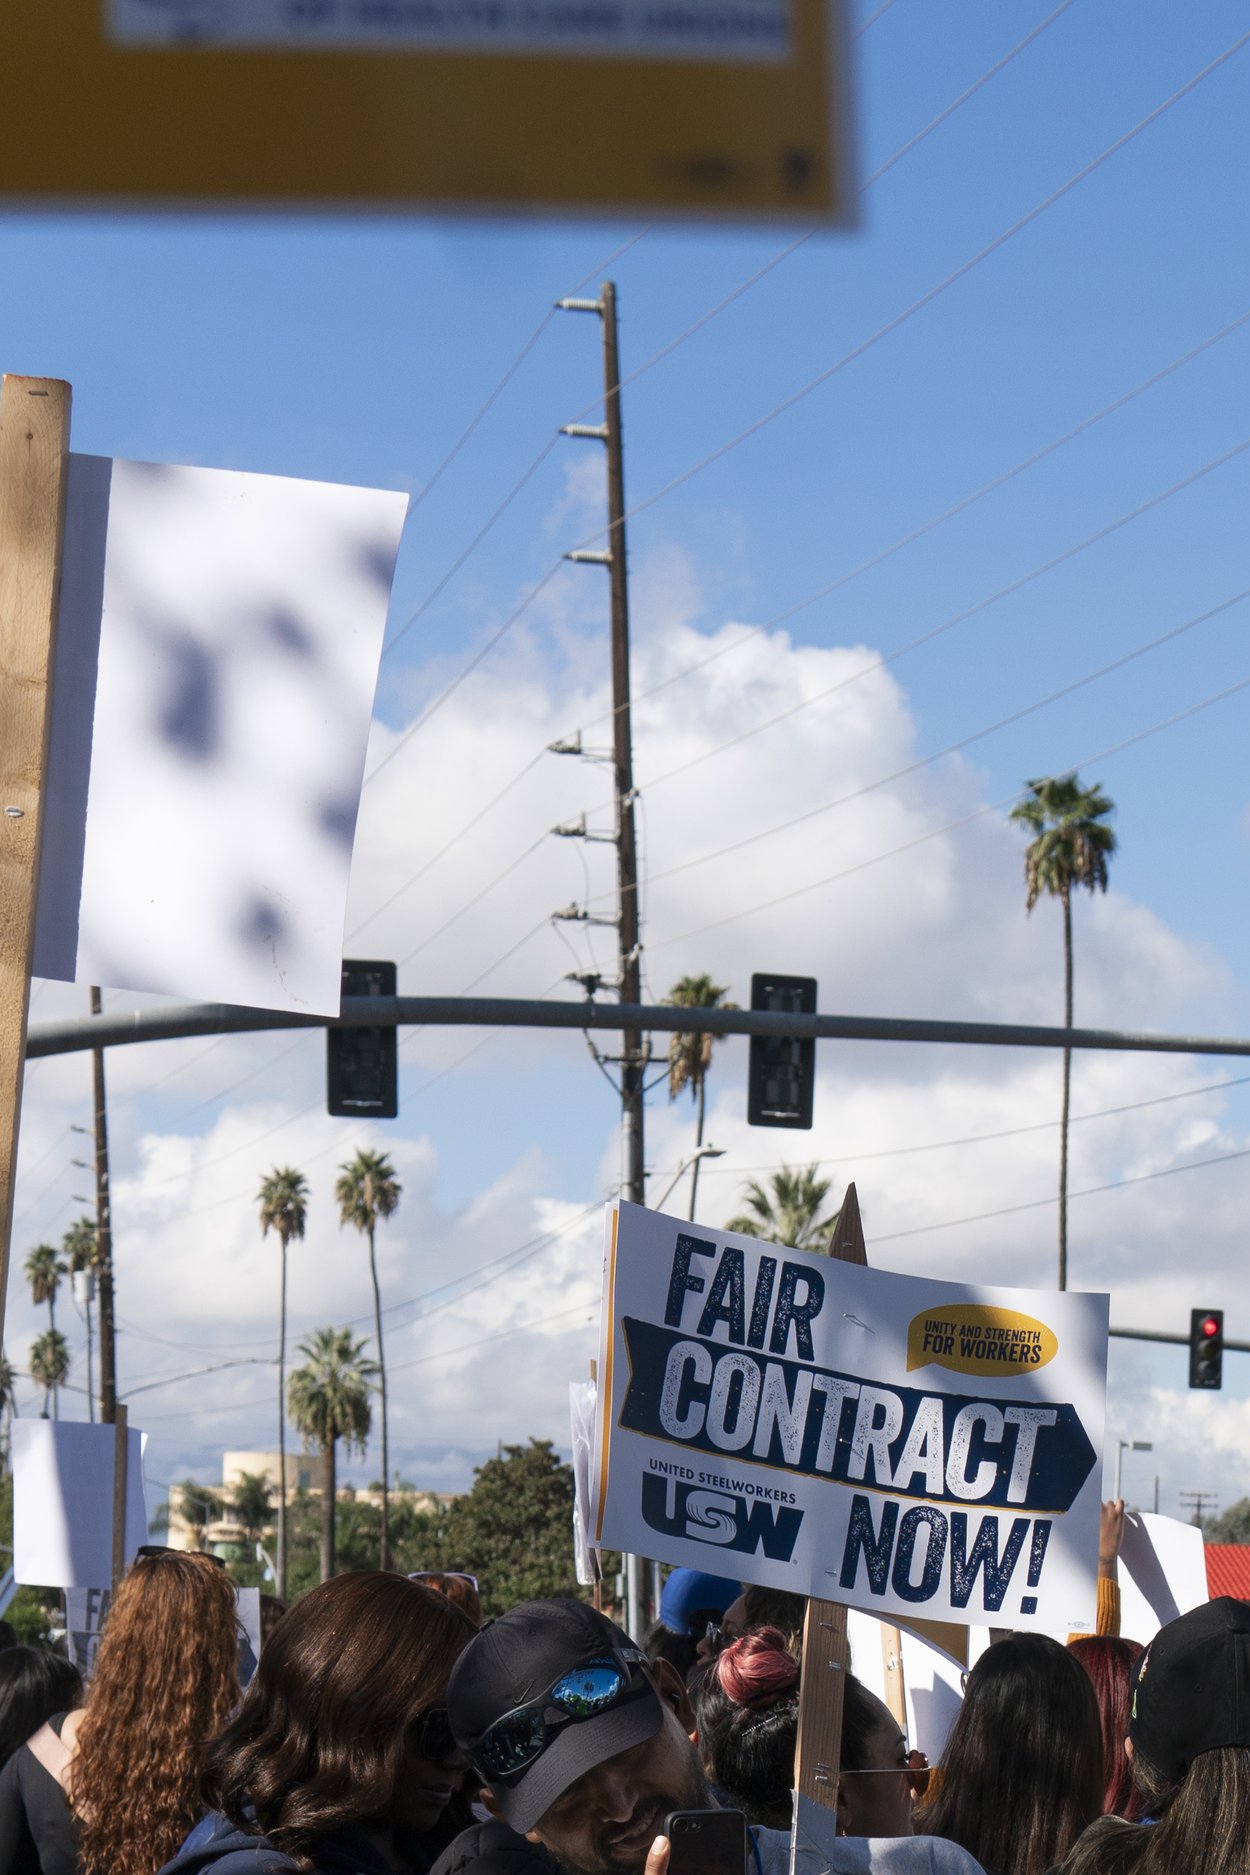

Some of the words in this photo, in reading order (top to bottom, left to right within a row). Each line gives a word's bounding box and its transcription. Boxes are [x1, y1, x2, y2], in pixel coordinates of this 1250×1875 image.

[664, 1233, 826, 1361] FAIR
[924, 1319, 957, 1335] UNITY
[959, 1325, 982, 1338] AND
[984, 1328, 1041, 1343] STRENGTH
[922, 1333, 955, 1356] FOR
[960, 1339, 1042, 1363] WORKERS
[660, 1340, 1057, 1504] CONTRACT
[641, 1471, 804, 1563] USW
[649, 1458, 694, 1480] UNITED
[698, 1472, 796, 1504] STEELWORKERS
[839, 1494, 1053, 1615] NOW!
